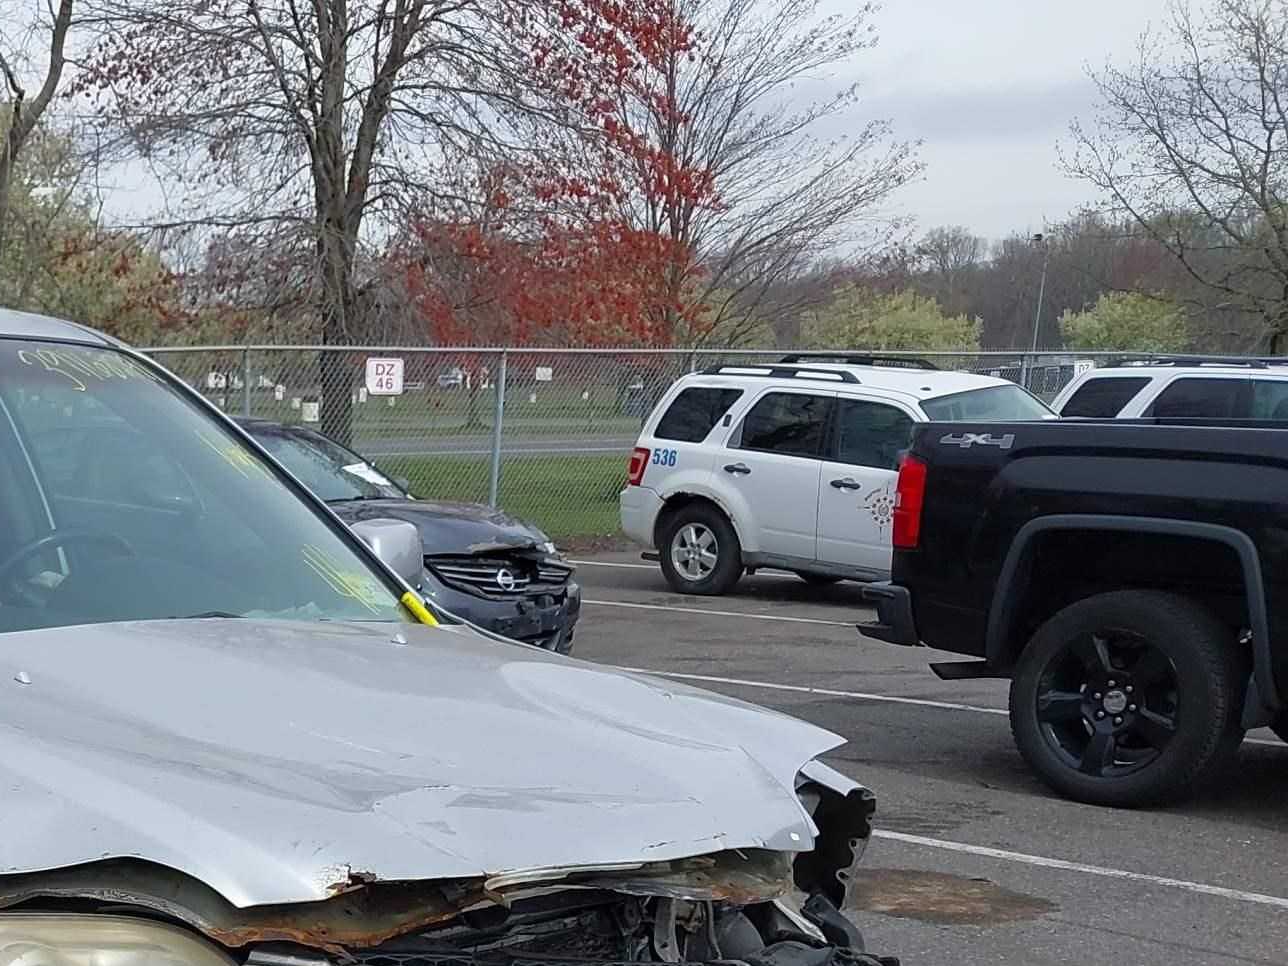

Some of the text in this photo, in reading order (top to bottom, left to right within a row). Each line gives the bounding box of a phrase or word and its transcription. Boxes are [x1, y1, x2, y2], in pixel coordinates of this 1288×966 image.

[375, 363, 395, 376] DZ
[375, 377, 394, 390] 46
[652, 447, 678, 467] 536
